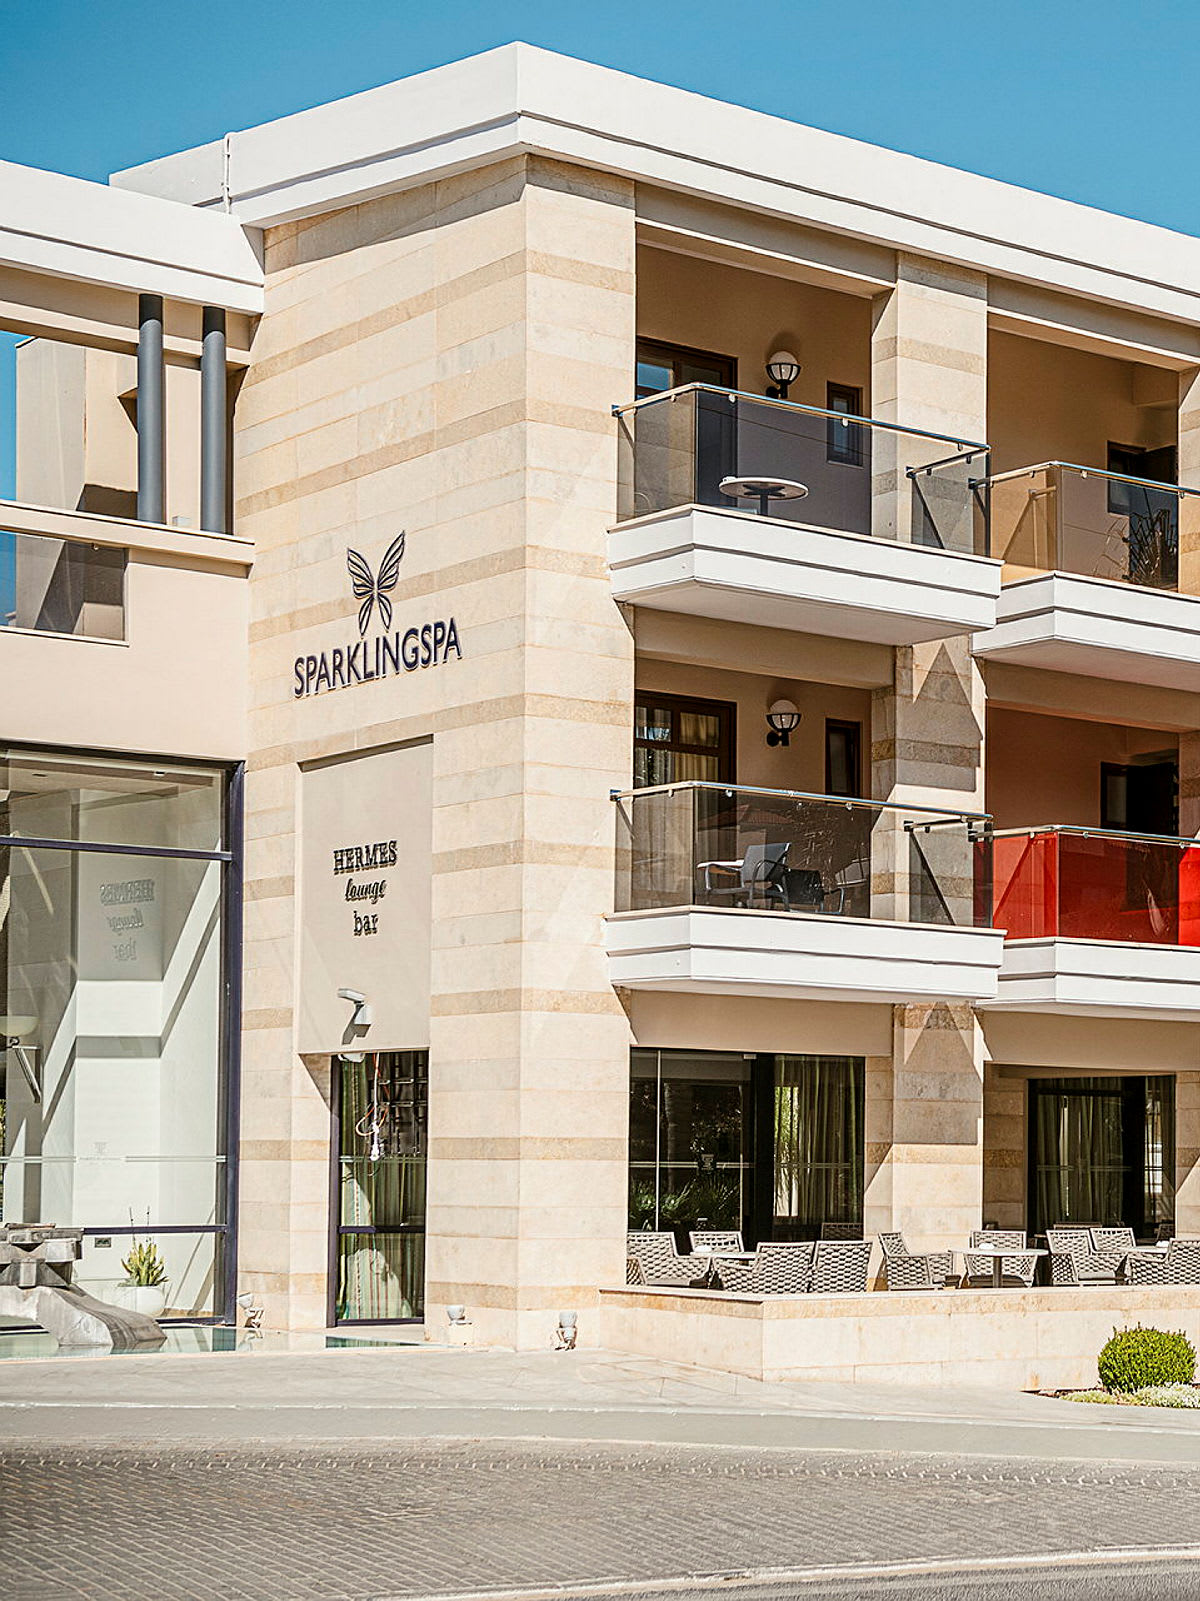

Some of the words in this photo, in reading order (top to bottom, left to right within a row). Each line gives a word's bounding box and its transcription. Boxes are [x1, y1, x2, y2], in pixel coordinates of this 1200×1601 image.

[294, 617, 463, 697] SPARKLINGSPA
[333, 840, 398, 873] HERMES
[345, 878, 387, 904] lounge
[353, 910, 378, 936] bar
